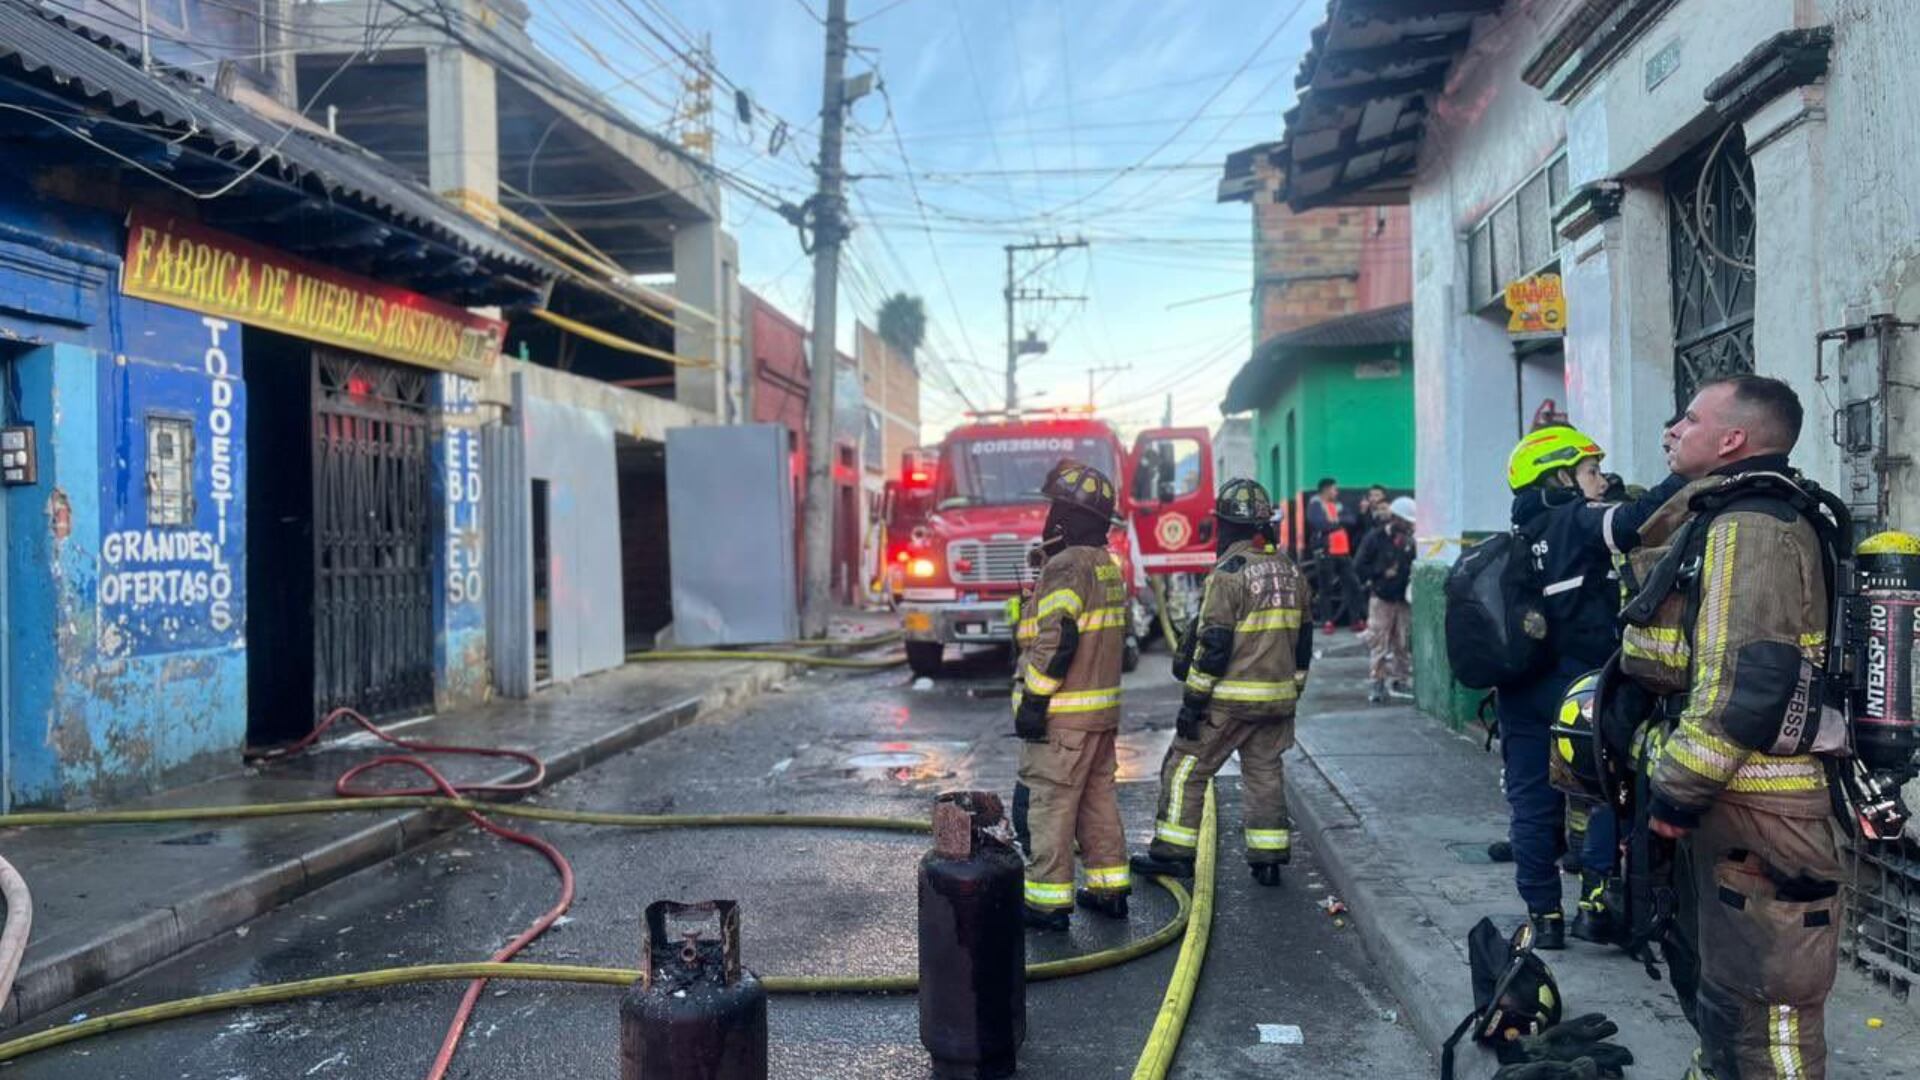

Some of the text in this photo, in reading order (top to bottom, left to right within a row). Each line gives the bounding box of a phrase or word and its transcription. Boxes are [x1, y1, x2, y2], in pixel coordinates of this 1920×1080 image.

[133, 218, 251, 309] FÁBRICA
[256, 263, 289, 316] DE
[290, 273, 385, 344] MUEBLES
[103, 529, 213, 565] GRANDES
[101, 569, 209, 607] OFERTAS
[1866, 604, 1887, 719] INTERSPIRO
